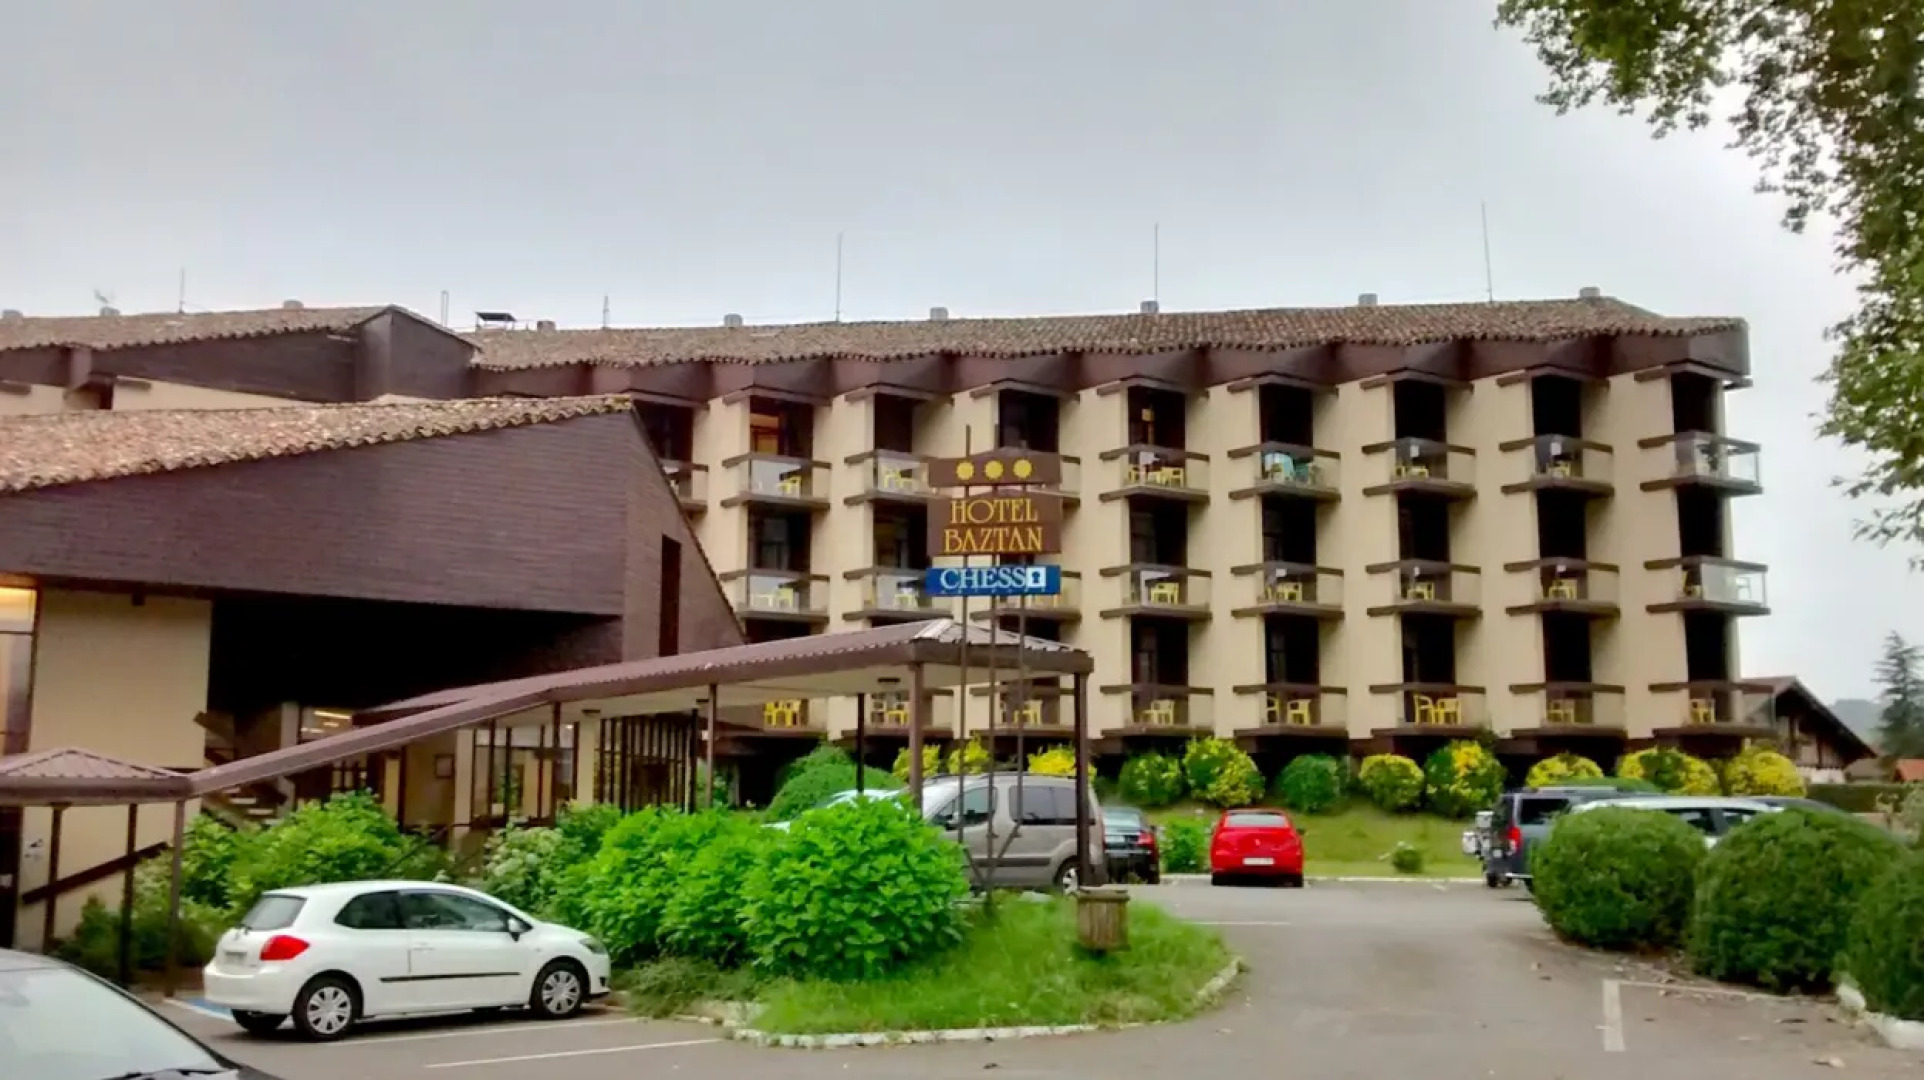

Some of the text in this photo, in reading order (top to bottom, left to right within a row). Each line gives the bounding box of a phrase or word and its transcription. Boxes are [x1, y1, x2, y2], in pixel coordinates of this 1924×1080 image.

[950, 498, 1038, 524] HOTEL
[944, 527, 1043, 553] BAZTAN
[940, 567, 1026, 589] CHESS
